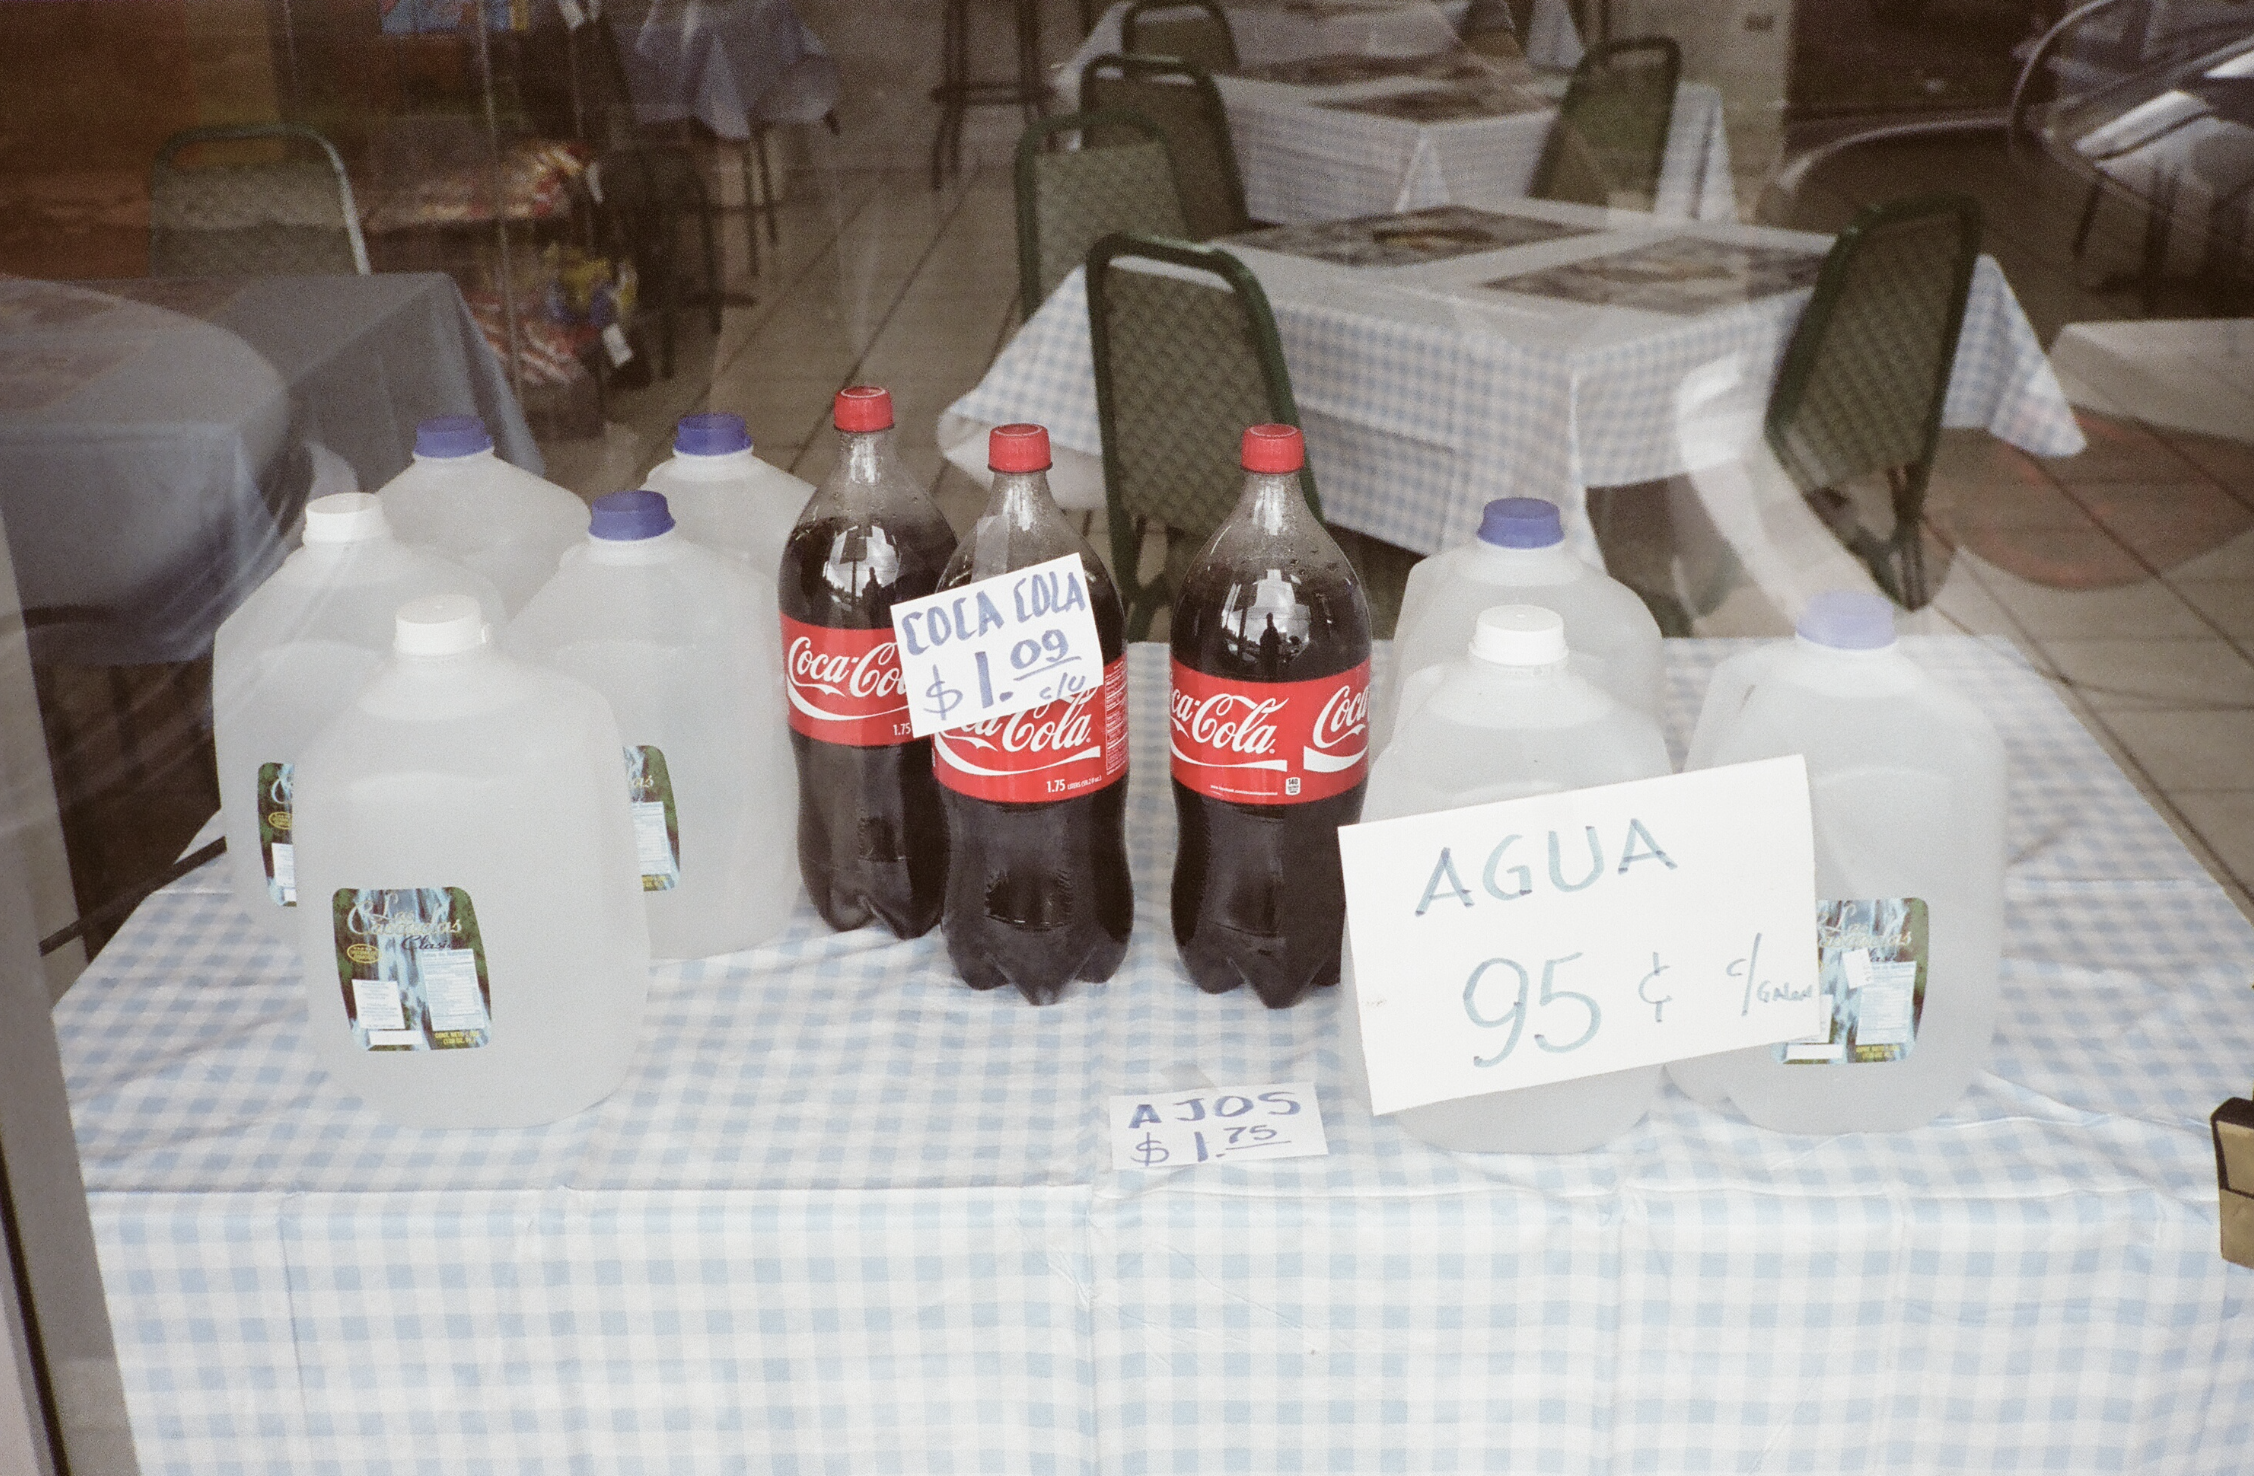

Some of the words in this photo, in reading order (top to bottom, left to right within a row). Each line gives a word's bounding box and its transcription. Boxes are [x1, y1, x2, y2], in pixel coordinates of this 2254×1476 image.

[901, 590, 1004, 656] COCA
[1013, 571, 1086, 624] COLA
[788, 636, 907, 698] Coca-Co
[1046, 778, 1066, 793] 1.75
[1414, 818, 1678, 917] AGUA
[1462, 951, 1602, 1068] 95
